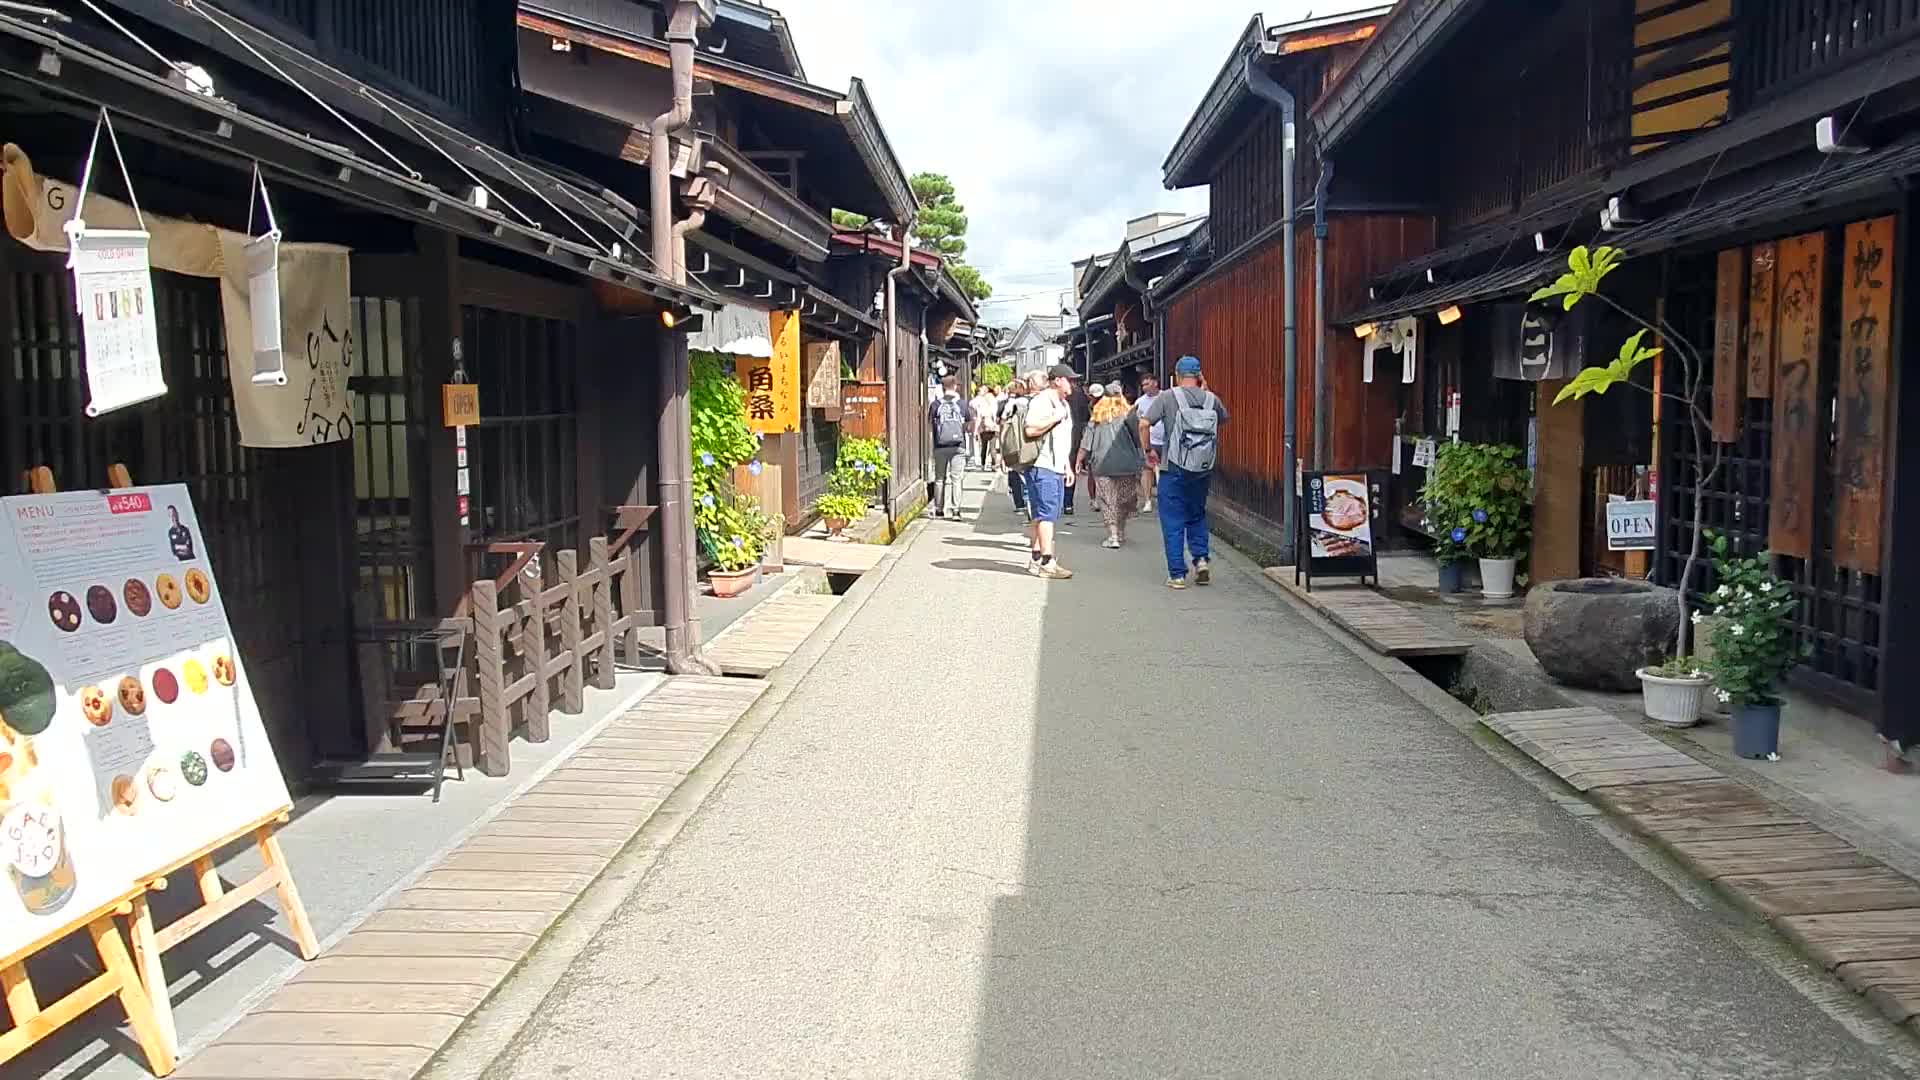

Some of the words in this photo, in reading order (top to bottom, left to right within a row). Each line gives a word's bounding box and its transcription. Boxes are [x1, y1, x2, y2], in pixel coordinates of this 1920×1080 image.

[453, 392, 474, 416] OPEN
[16, 504, 55, 520] MENU
[1611, 517, 1653, 534] OPEN
